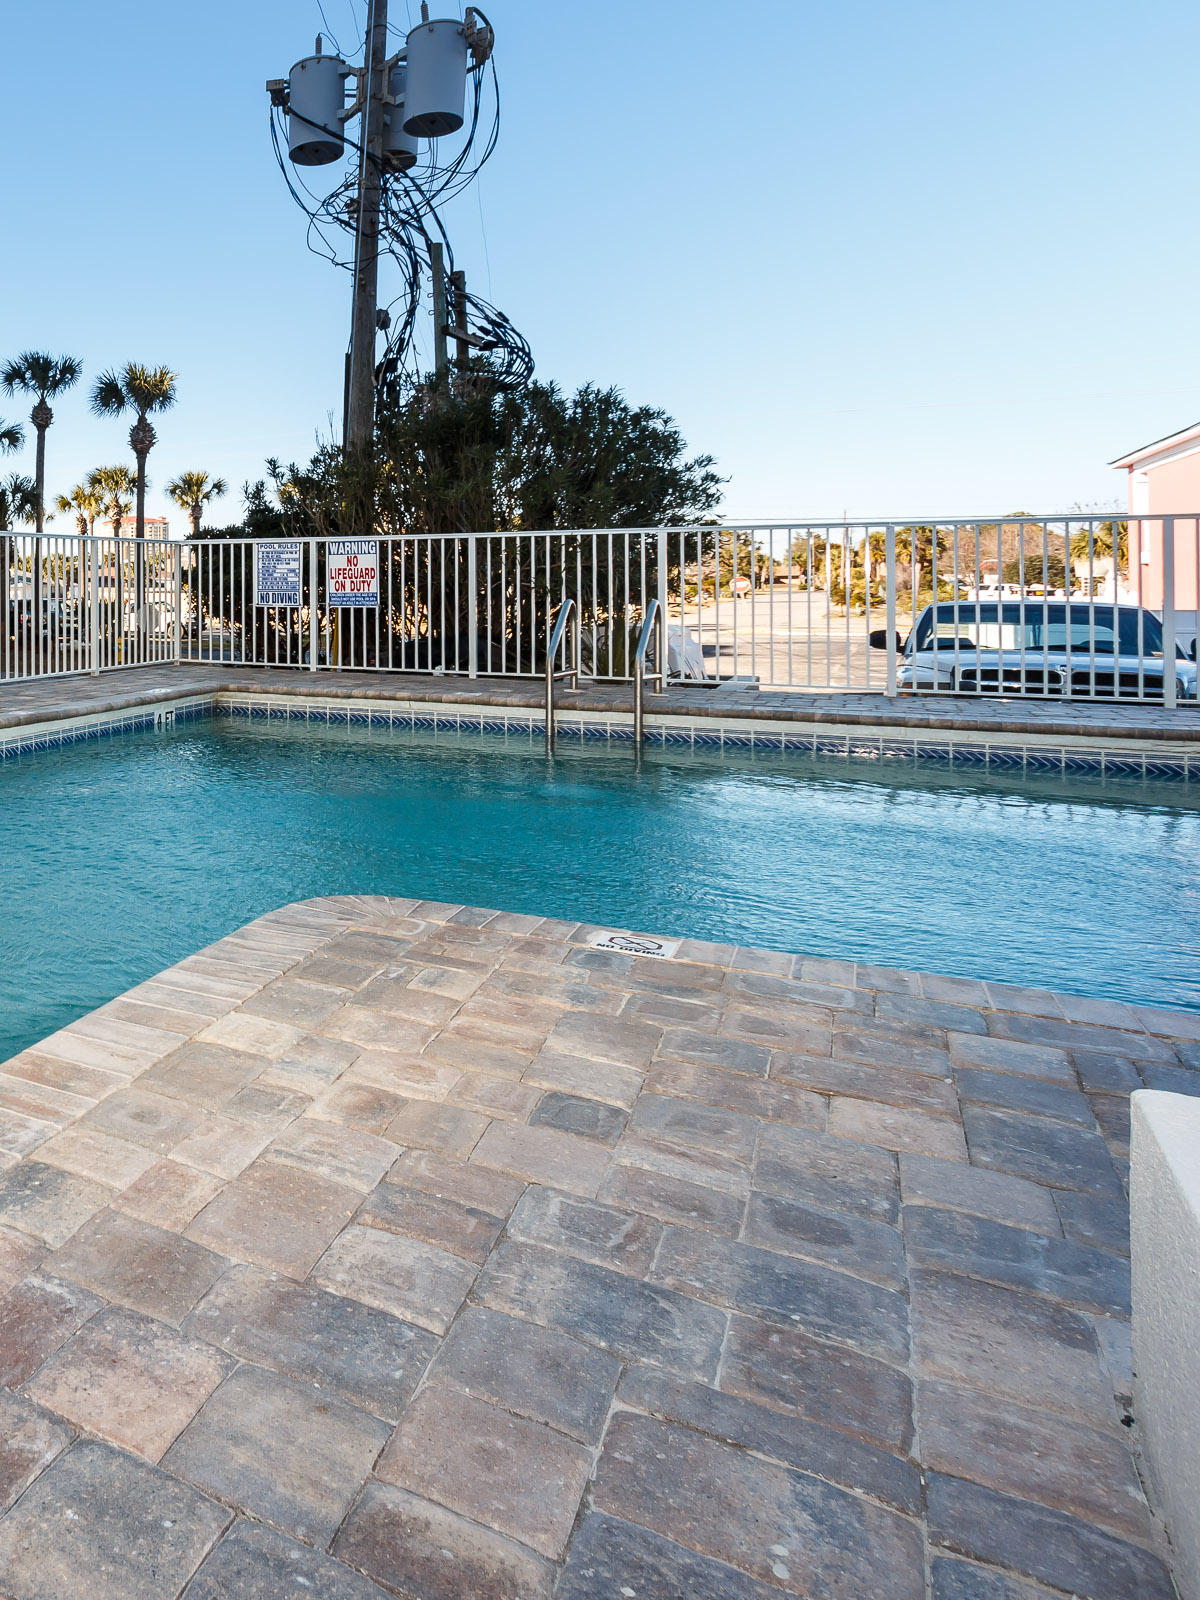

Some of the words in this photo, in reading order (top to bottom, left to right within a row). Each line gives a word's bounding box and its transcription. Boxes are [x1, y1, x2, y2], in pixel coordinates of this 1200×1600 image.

[329, 542, 376, 554] WARNING
[347, 555, 359, 567] NO
[330, 568, 376, 580] LIFEGUARD
[335, 580, 346, 592] ON
[350, 580, 372, 592] DUTY
[260, 592, 270, 604] NO
[271, 592, 298, 604] DIVING
[165, 710, 174, 723] FT
[619, 946, 666, 957] DIVING
